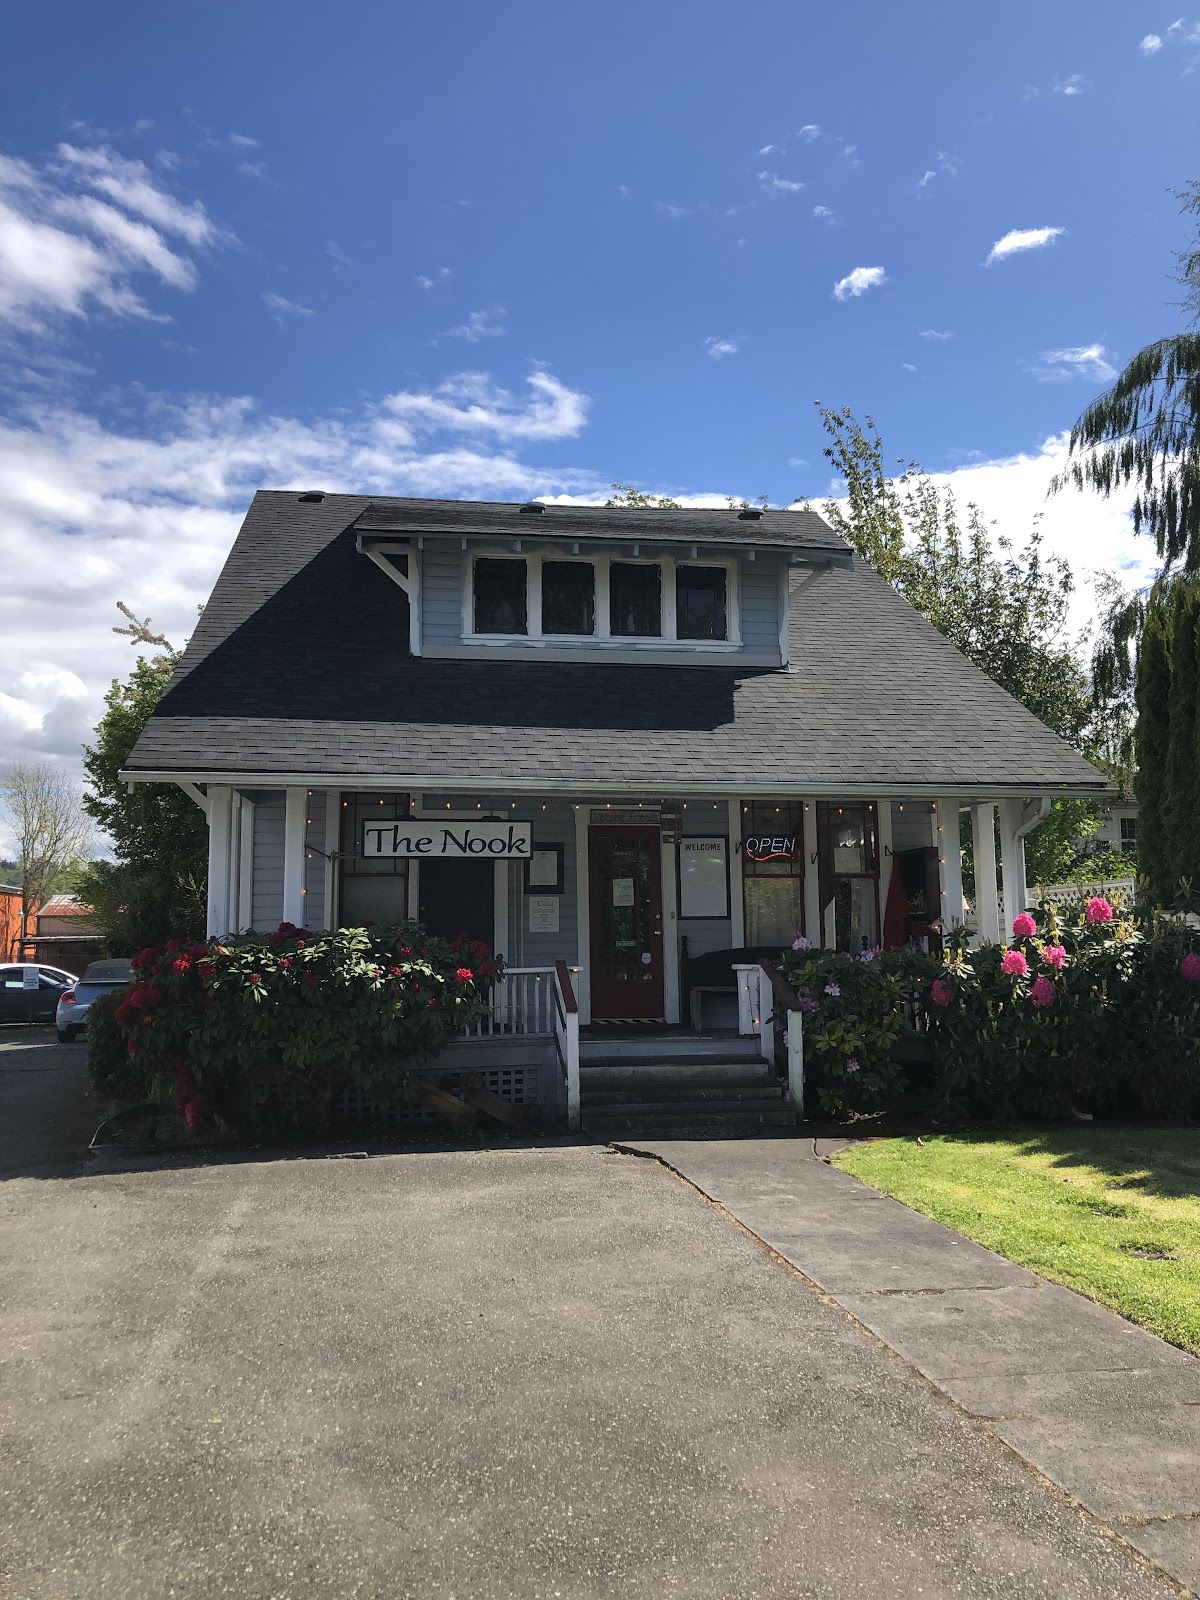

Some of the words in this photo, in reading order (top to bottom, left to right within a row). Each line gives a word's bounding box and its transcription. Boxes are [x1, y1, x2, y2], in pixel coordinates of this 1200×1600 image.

[629, 811, 659, 823] Friends
[366, 825, 433, 853] The
[440, 825, 529, 854] Nook
[746, 837, 796, 853] OPEN
[684, 843, 722, 851] WELCOME
